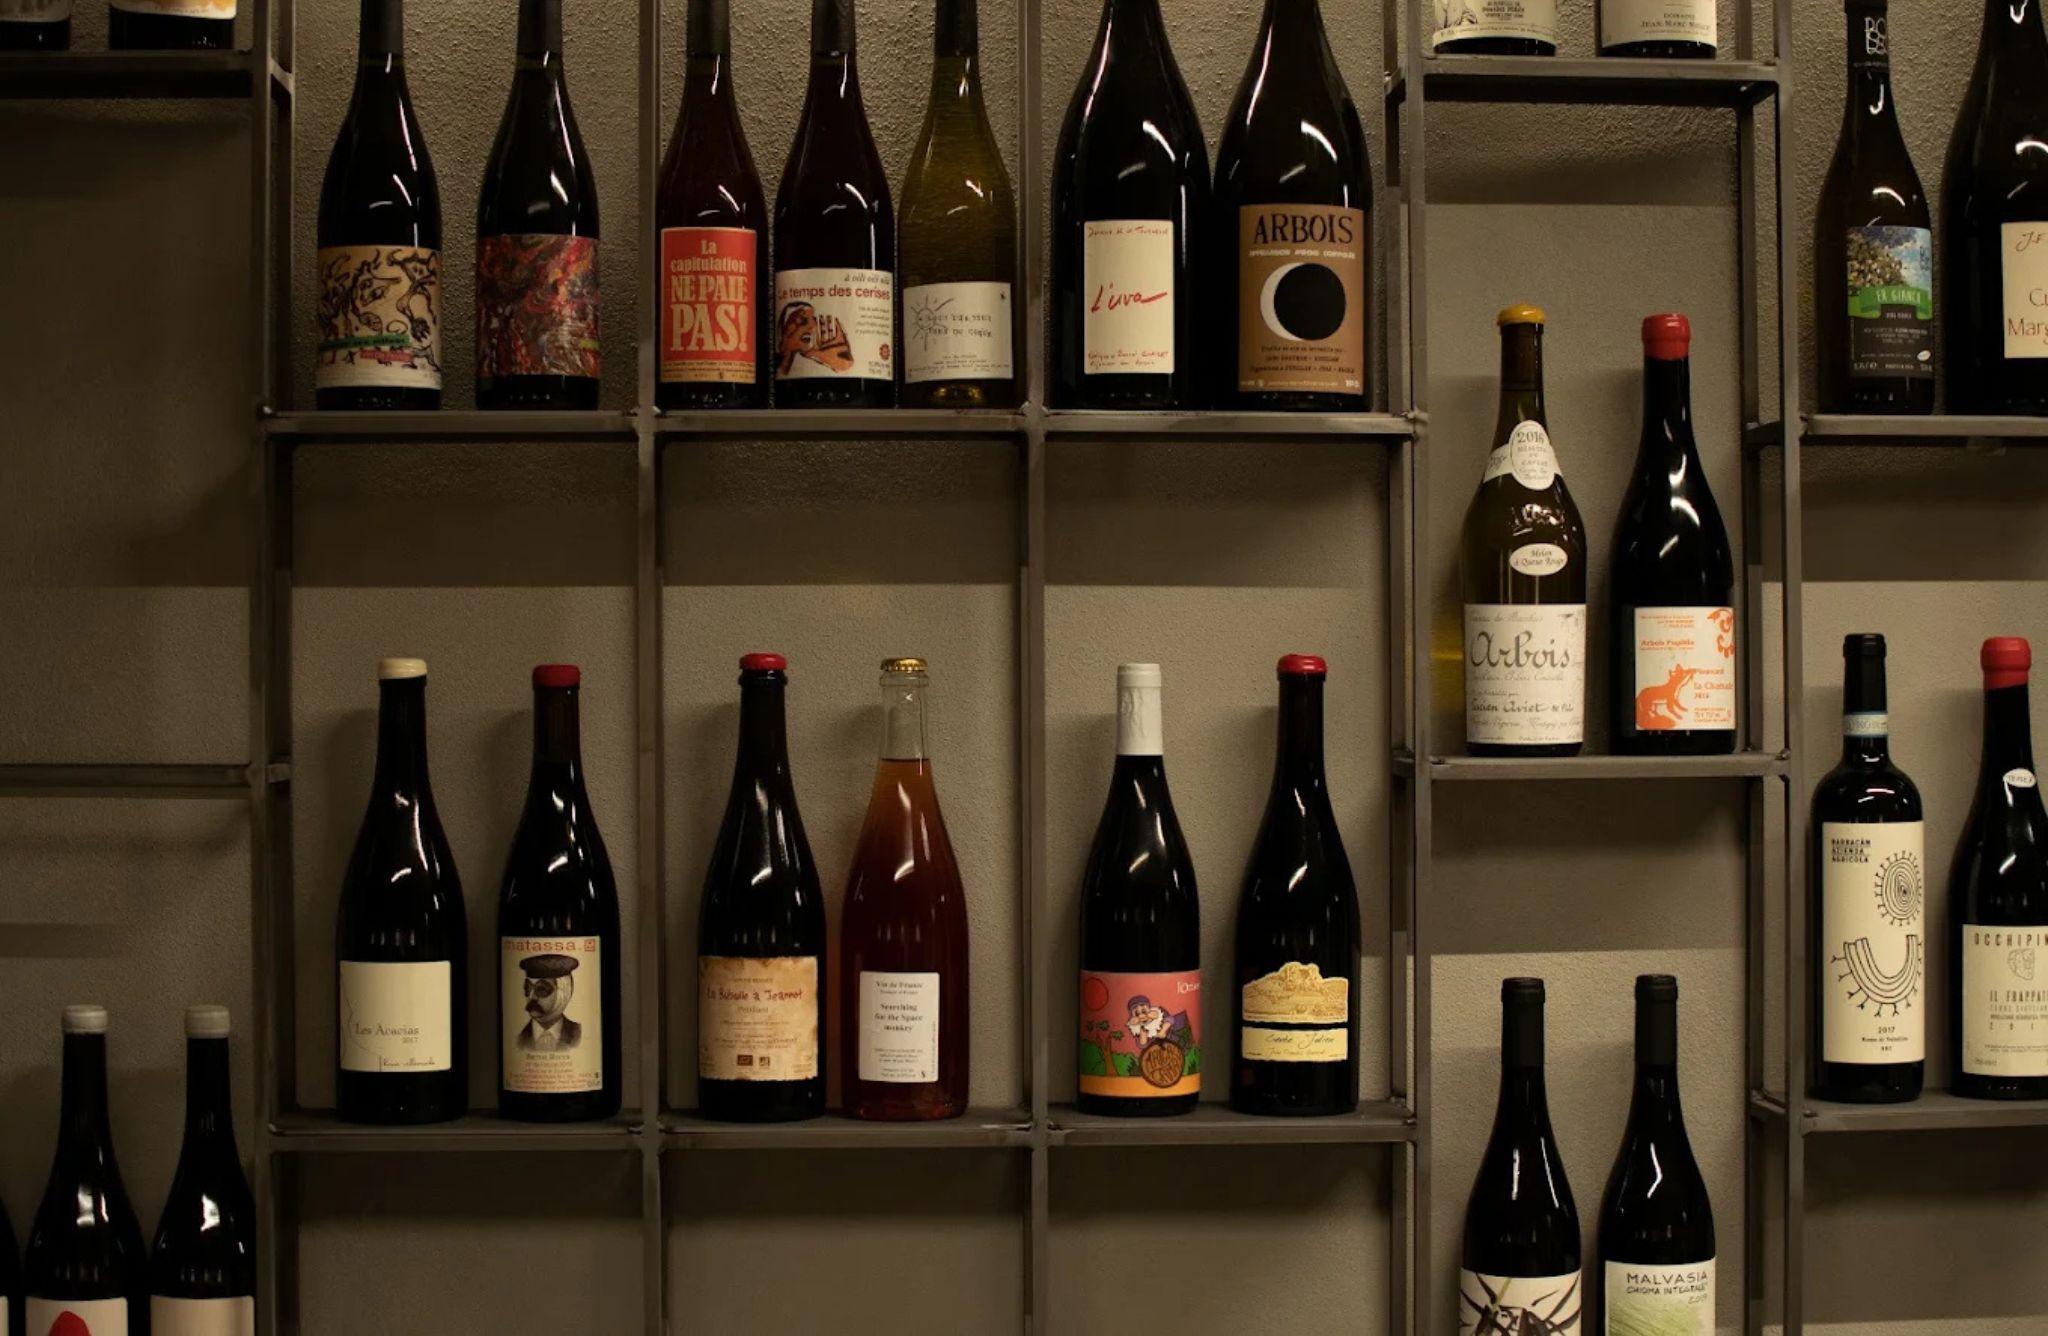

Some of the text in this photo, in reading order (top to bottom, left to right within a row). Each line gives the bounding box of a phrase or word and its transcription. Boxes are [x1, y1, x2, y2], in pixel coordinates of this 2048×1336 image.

[1253, 213, 1353, 245] ARBOIS
[702, 239, 717, 255] La
[670, 256, 748, 273] capitulation
[670, 275, 749, 303] NE PAIE
[789, 287, 825, 300] temps
[828, 284, 852, 297] des
[855, 286, 891, 301] cerises
[670, 303, 749, 353] PAS!
[1470, 629, 1571, 668] Arbois
[899, 981, 923, 989] France
[2006, 990, 2048, 1002] FRAPPAT
[880, 1003, 918, 1011] Searching
[888, 1013, 899, 1021] the
[901, 1013, 923, 1022] Space
[355, 1022, 420, 1036] Les Acacias
[1877, 1026, 1896, 1034] 2017
[1626, 1270, 1708, 1285] MALVASIA
